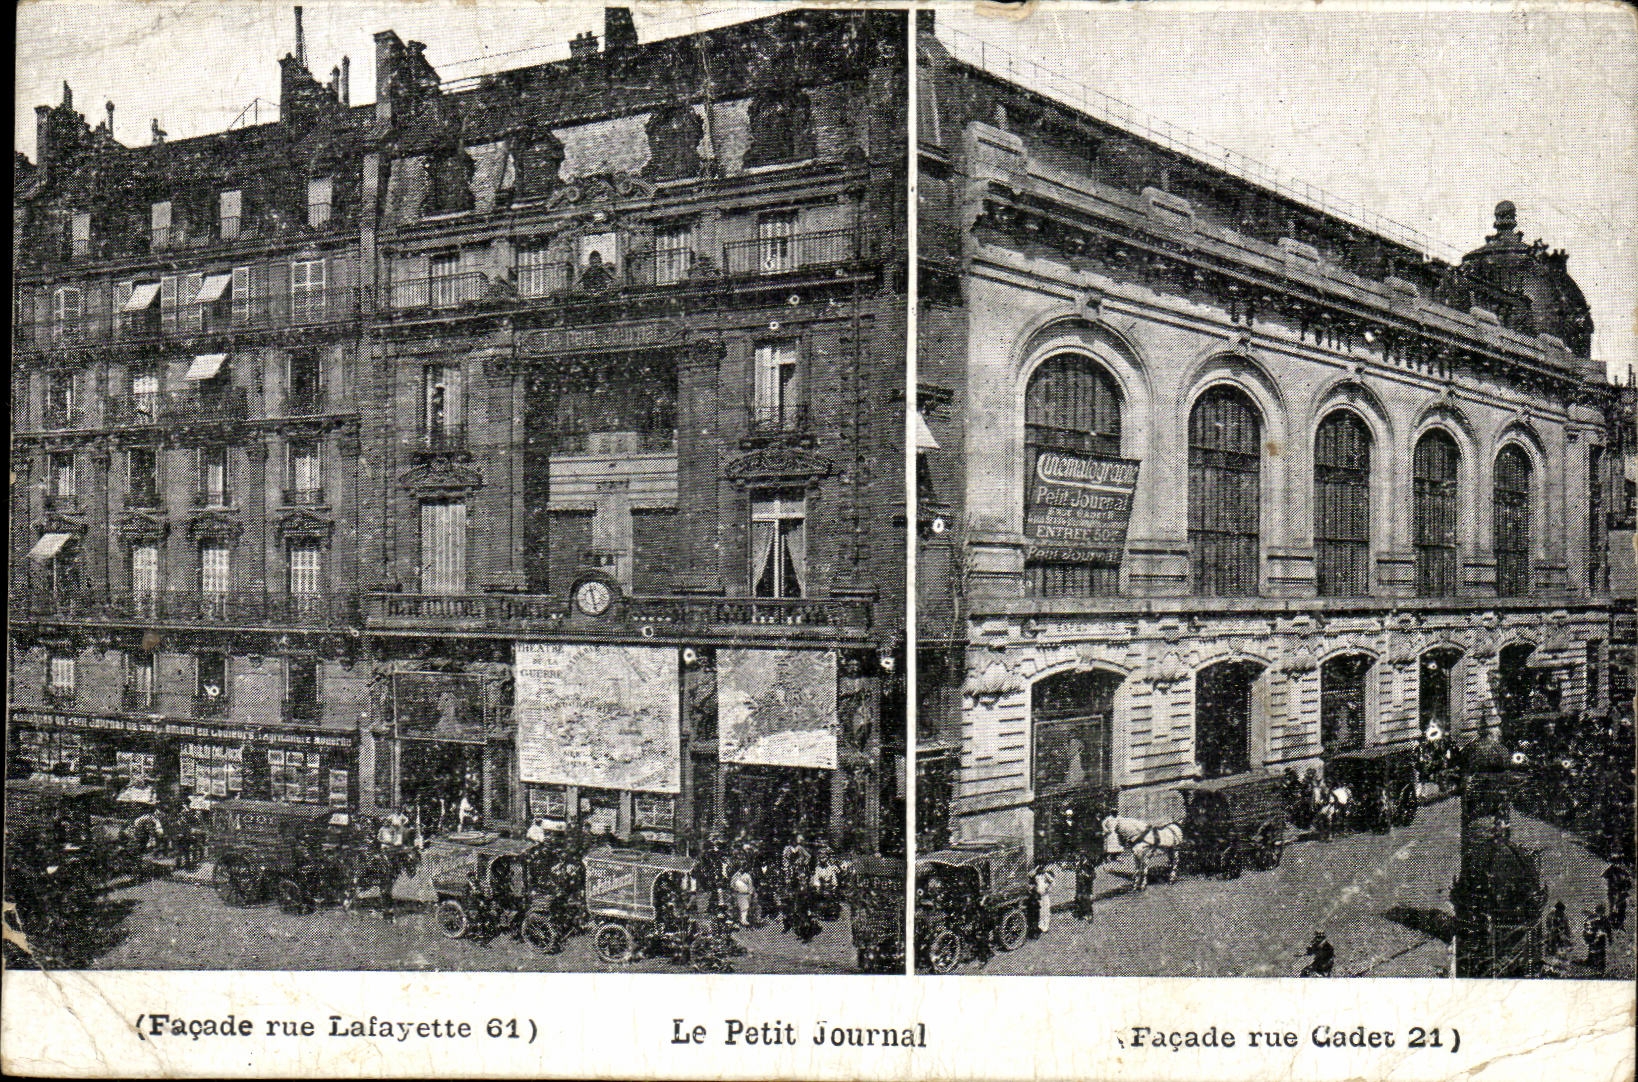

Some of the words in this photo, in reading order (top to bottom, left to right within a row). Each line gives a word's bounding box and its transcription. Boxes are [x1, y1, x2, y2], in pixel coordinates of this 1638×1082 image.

[1036, 485, 1069, 506] Petit
[1070, 489, 1129, 511] Journal
[1026, 545, 1059, 561] Petit
[1061, 549, 1119, 563] Journal
[520, 668, 563, 680] GUERRE
